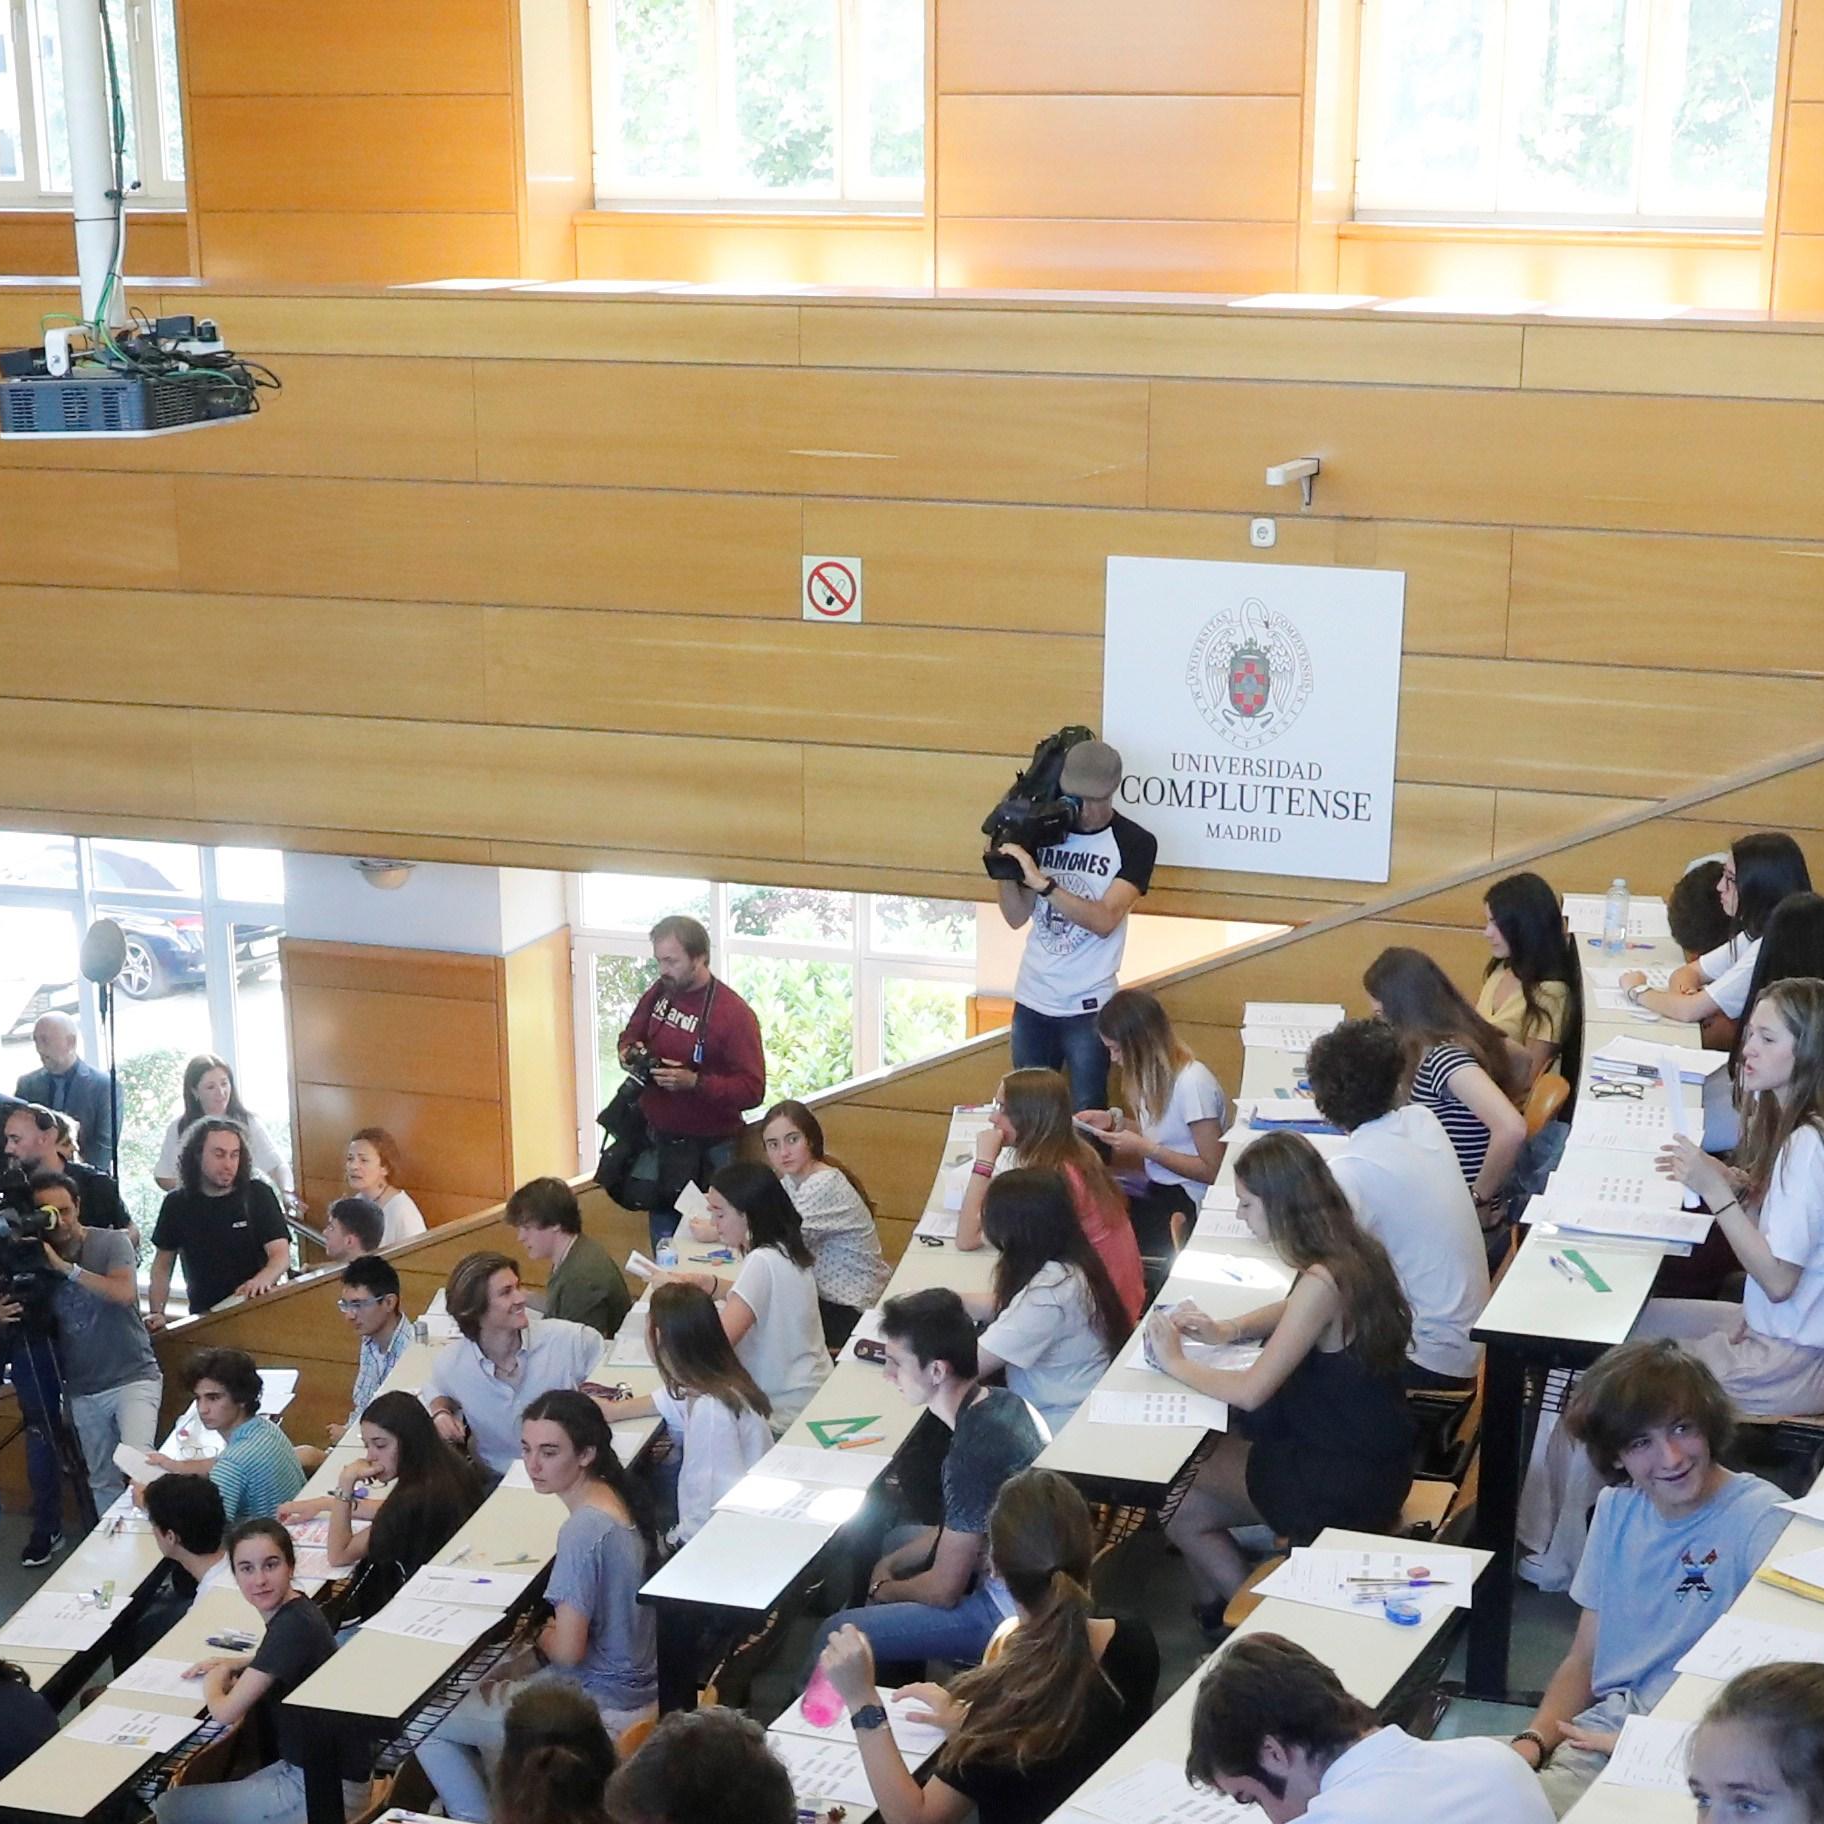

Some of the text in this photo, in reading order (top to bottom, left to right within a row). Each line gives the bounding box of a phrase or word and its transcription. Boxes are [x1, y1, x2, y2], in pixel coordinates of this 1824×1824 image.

[1170, 752, 1323, 782] UNIVERSIDAD
[1120, 775, 1372, 822] COMPLUTENSE
[1205, 822, 1282, 844] MADRID
